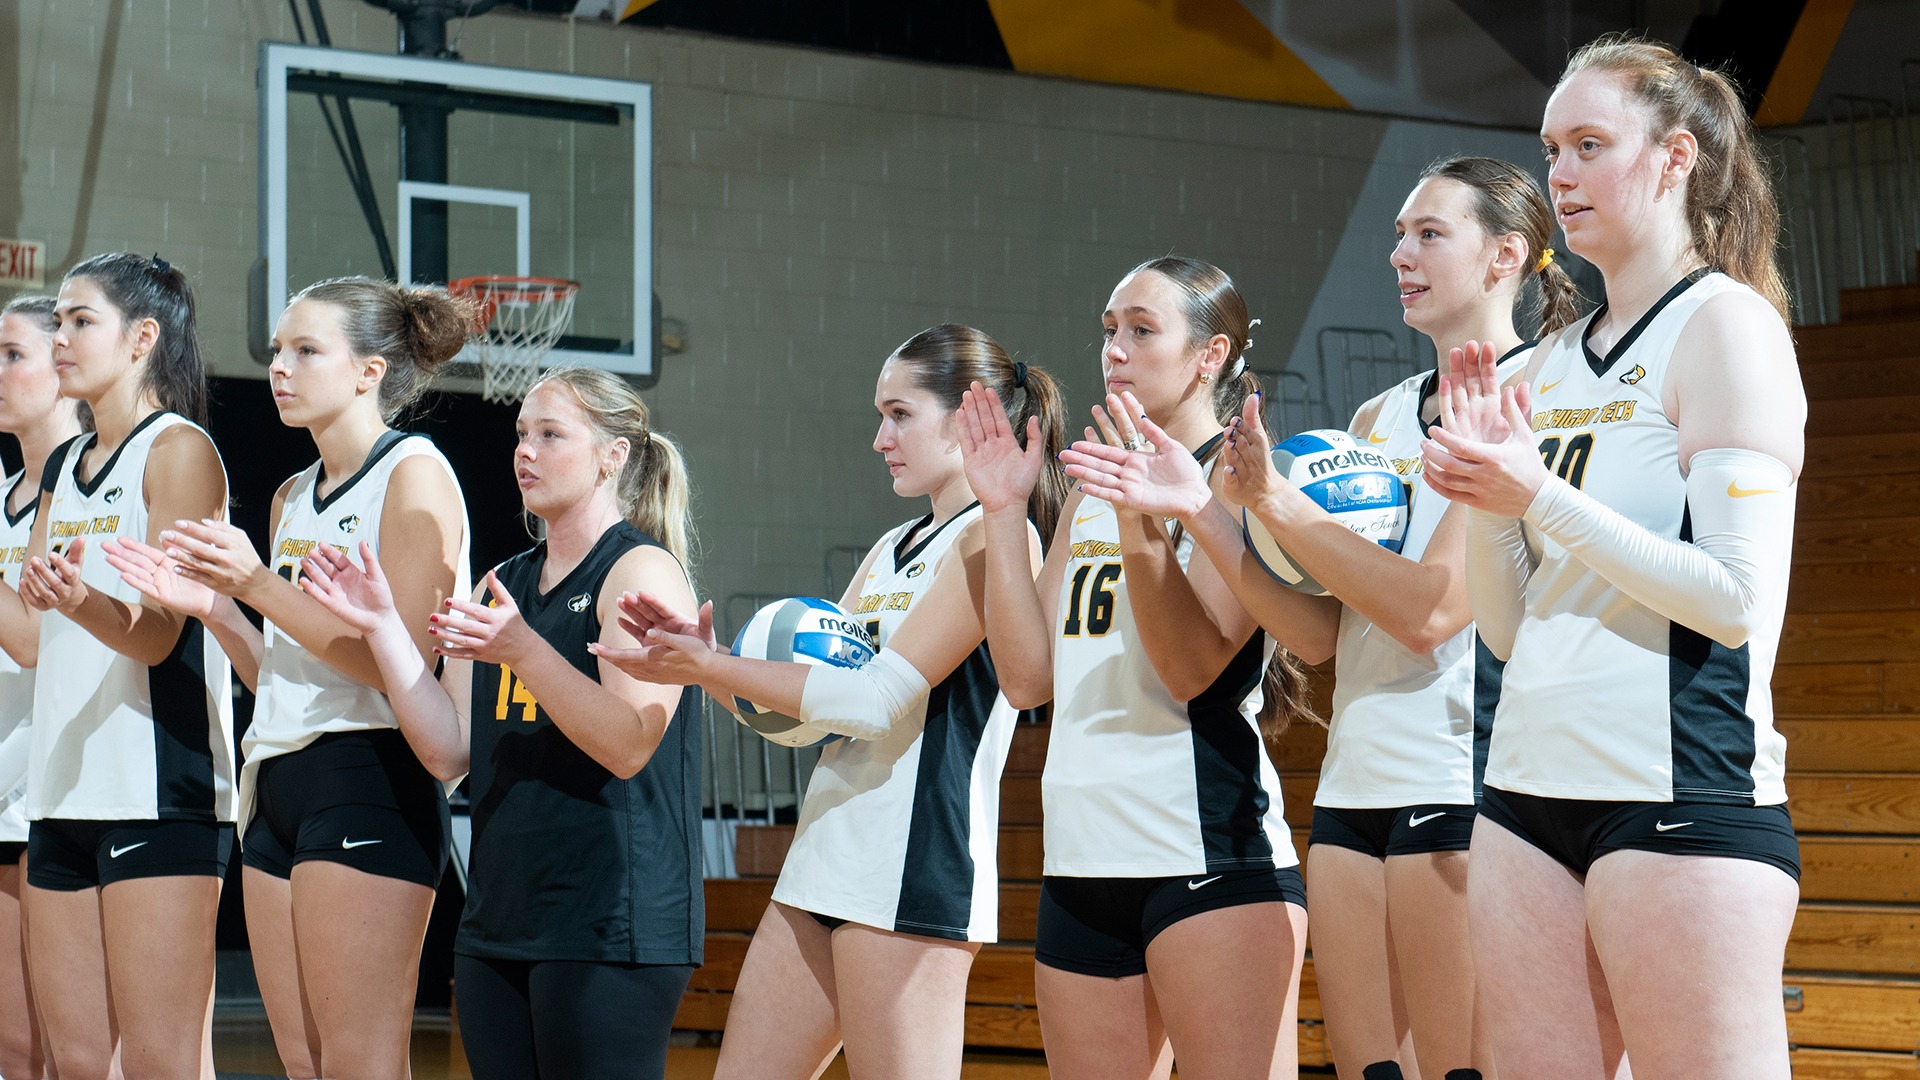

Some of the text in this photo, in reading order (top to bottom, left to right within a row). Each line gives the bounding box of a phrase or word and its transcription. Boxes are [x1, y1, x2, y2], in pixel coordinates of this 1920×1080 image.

[0, 243, 37, 280] EXIT
[1593, 400, 1638, 424] TECH
[1308, 450, 1390, 478] molten
[1326, 475, 1392, 505] NCAA
[8, 547, 27, 563] TE
[1063, 562, 1124, 638] 16
[819, 617, 876, 650] molte
[828, 641, 870, 667] NCA
[495, 662, 537, 721] 14
